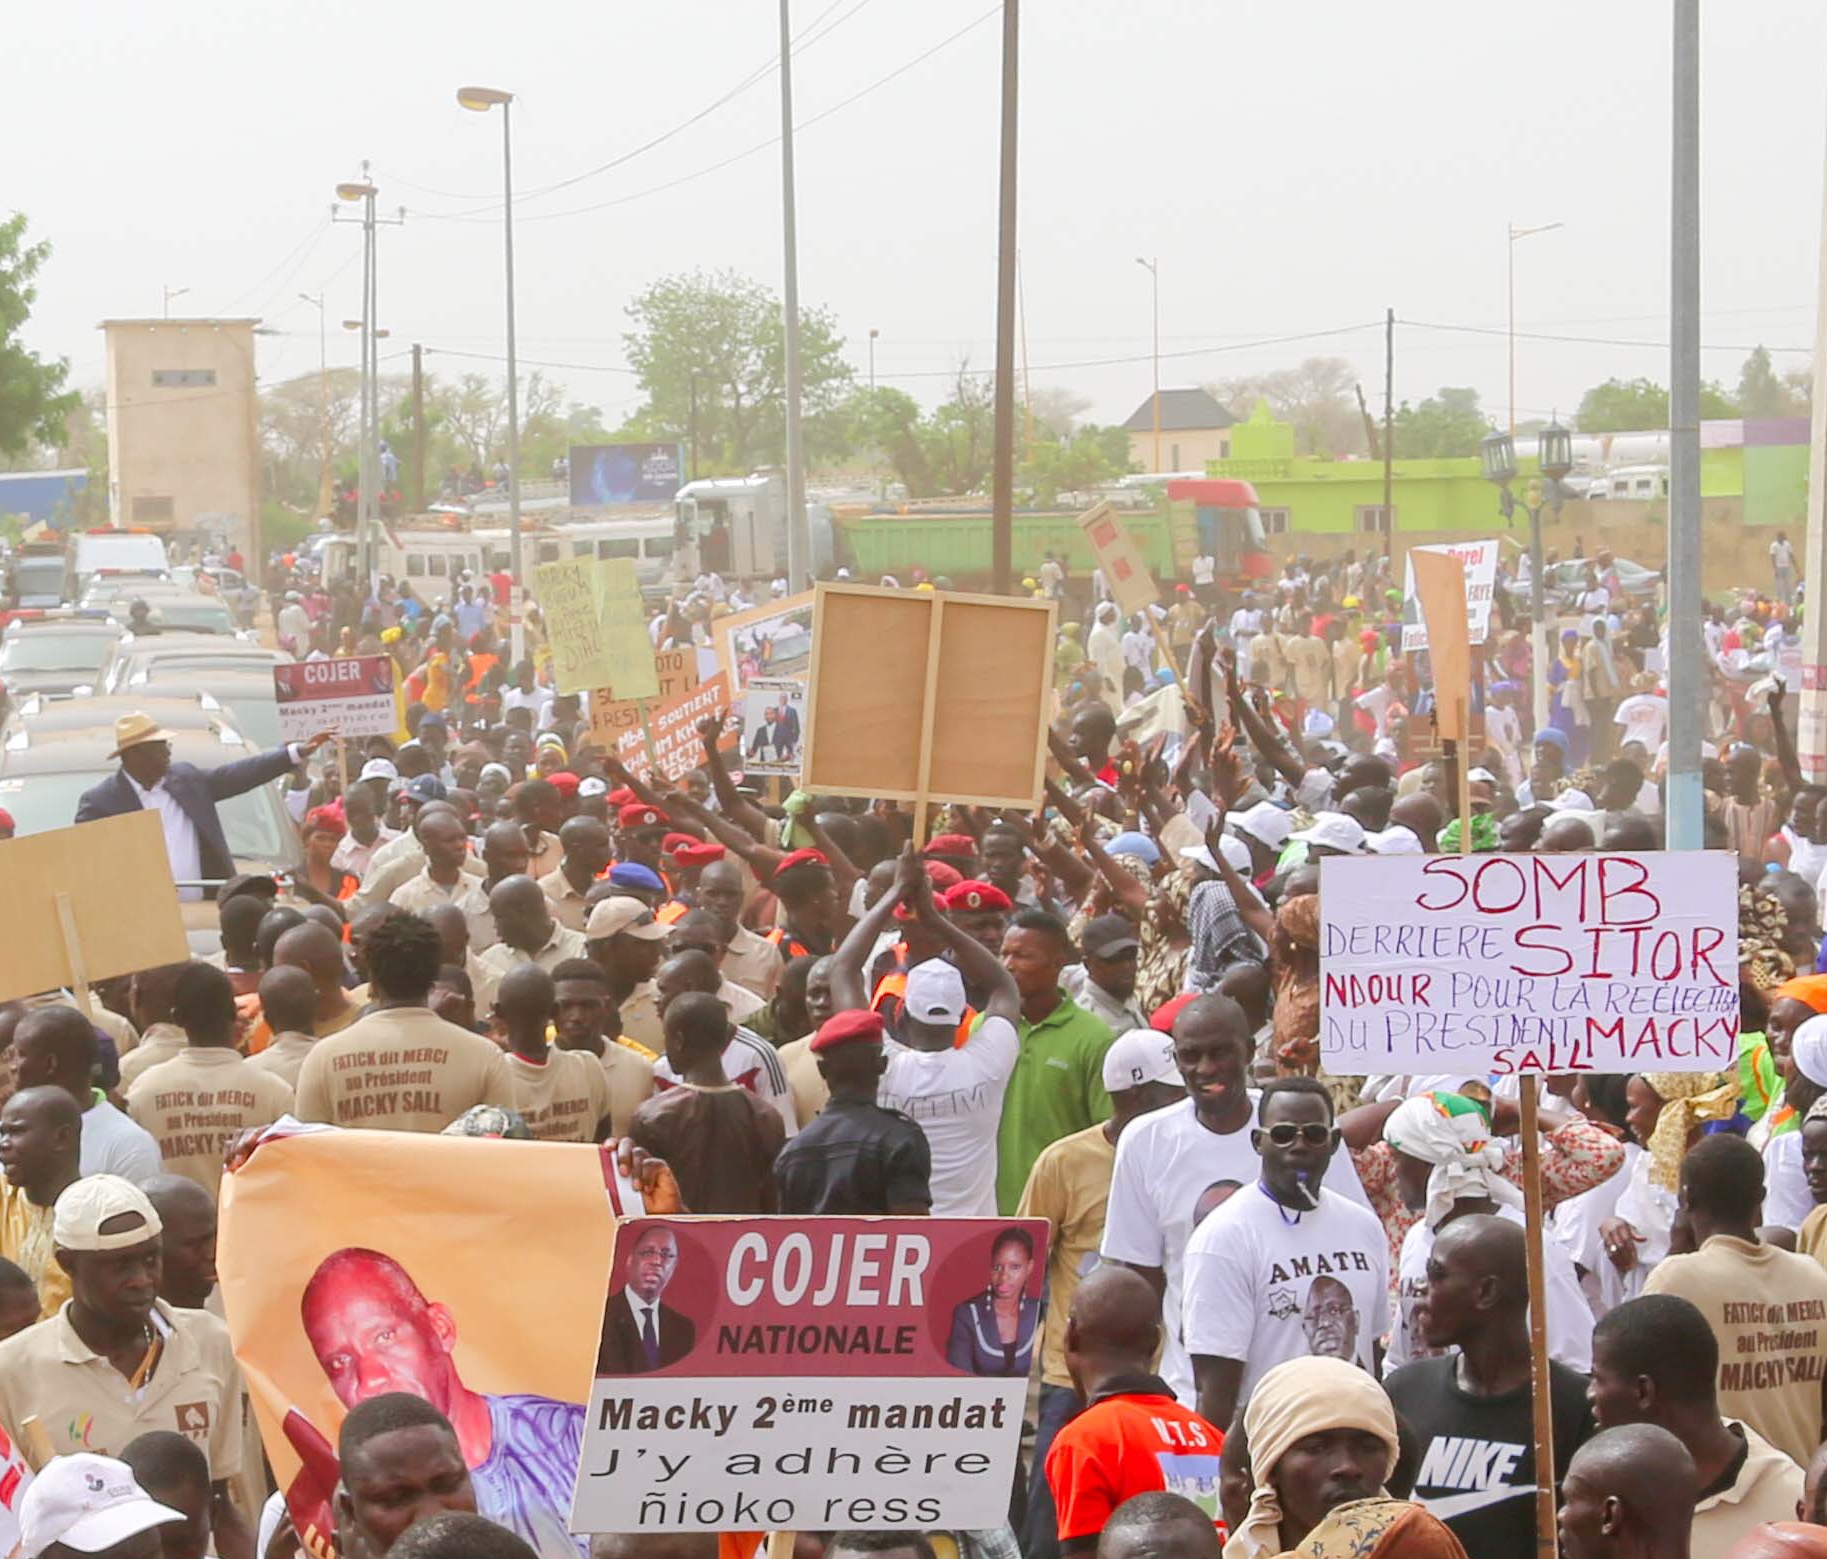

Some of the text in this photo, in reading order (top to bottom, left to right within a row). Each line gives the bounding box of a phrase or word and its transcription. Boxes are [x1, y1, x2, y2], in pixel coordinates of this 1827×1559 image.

[304, 660, 362, 684] COJER
[1416, 856, 1661, 926] SOMB
[1324, 922, 1732, 988] DERRIERE SITOR
[1325, 971, 1591, 1013] NDOUR POUR LA
[1321, 1009, 1741, 1060] DU PRESIDENT MACKY
[332, 1047, 449, 1072] FATICK dit MERCI
[1490, 1039, 1595, 1075] SALL
[345, 1068, 434, 1091] au Président
[155, 1089, 257, 1110] FATICK dit MERCI
[337, 1091, 442, 1122] MACKY SALL
[180, 1110, 243, 1129] Président
[158, 1132, 216, 1162] MACKY
[724, 1231, 933, 1309] COJER
[1269, 1250, 1371, 1286] AMATH
[715, 1324, 918, 1356] NATIONALE
[1736, 1334, 1757, 1353] au
[1720, 1360, 1785, 1391] MACKY
[597, 1394, 1007, 1438] Macky 2ème mandat
[589, 1444, 993, 1484] J'y adhère
[1418, 1436, 1527, 1488] NIKE
[637, 1489, 943, 1527] ñioko ress
